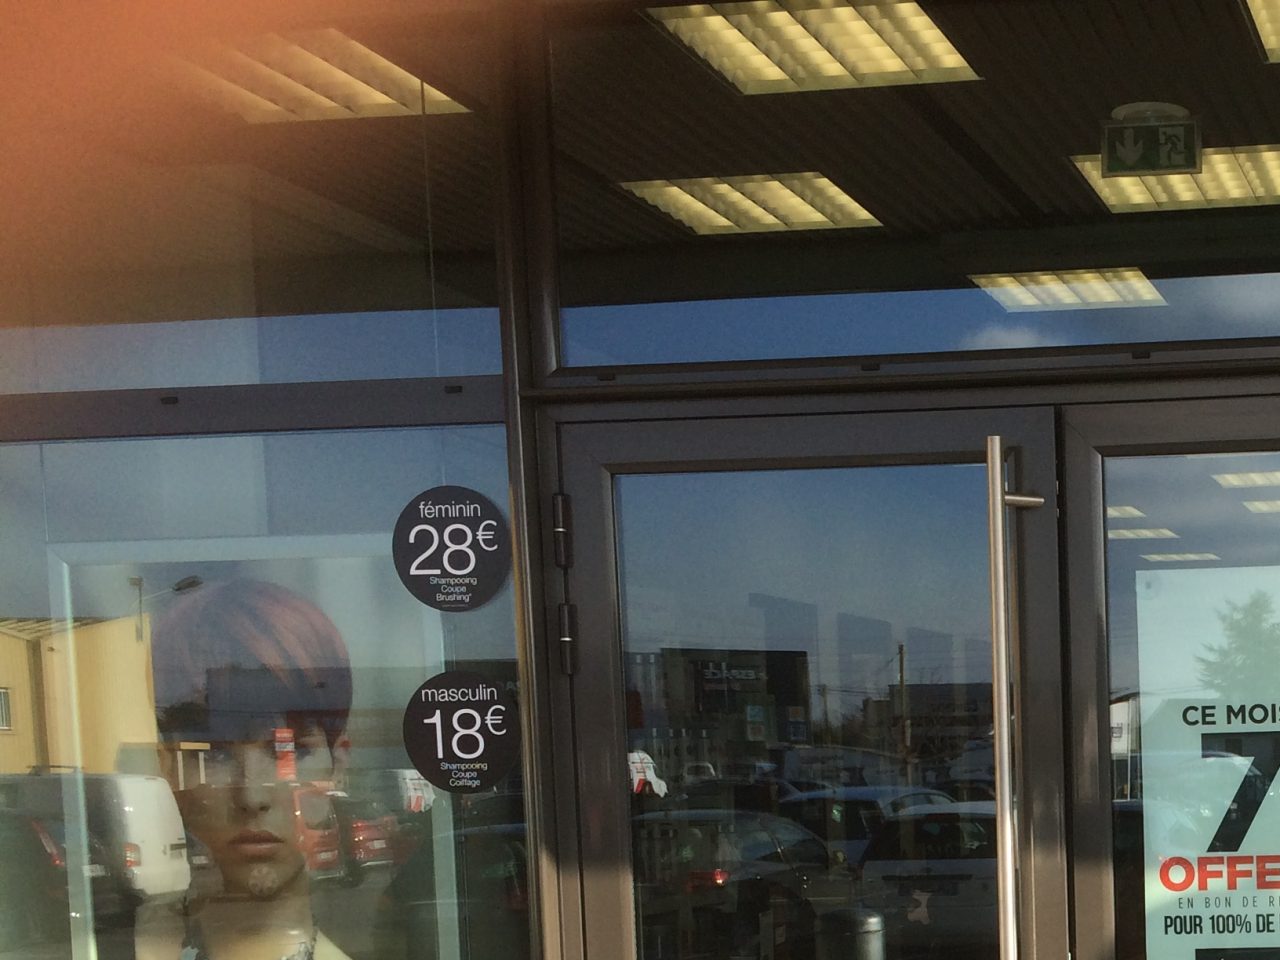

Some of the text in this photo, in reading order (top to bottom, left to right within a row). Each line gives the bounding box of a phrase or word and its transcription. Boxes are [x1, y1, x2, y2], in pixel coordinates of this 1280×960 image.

[419, 501, 482, 518] féminin
[408, 519, 499, 576] 28€
[429, 575, 478, 586] Shampooing
[440, 584, 467, 595] Coupe
[421, 684, 498, 702] masculin
[1182, 705, 1217, 726] CE
[423, 704, 507, 760] 18€
[440, 761, 488, 772] Shampooing
[449, 777, 481, 788] Coiffage
[451, 770, 477, 780] Coupe
[1178, 897, 1194, 909] EN
[1205, 896, 1232, 909] BON
[1242, 896, 1258, 908] DE
[1164, 915, 1203, 935] POUR
[1209, 914, 1251, 934] 100%
[1256, 913, 1275, 933] DE
